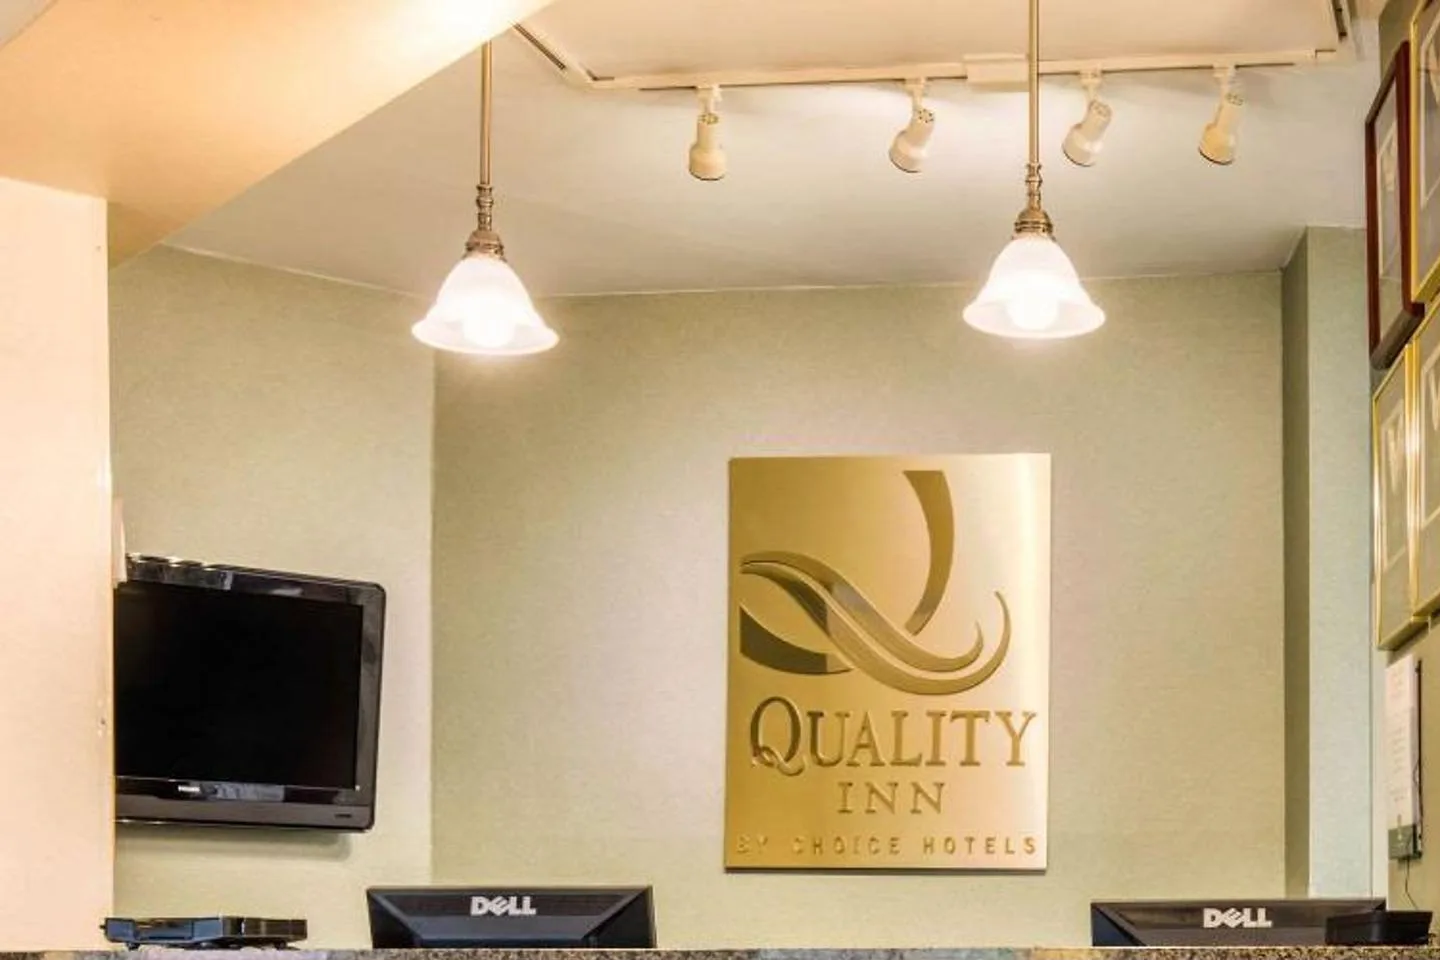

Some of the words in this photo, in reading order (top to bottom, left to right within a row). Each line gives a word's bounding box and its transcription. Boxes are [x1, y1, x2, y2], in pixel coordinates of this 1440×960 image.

[749, 696, 1038, 777] QUALITY
[837, 782, 945, 815] INN
[736, 833, 769, 856] BY
[792, 835, 901, 856] CHOICE
[923, 836, 1037, 856] HOTELS
[470, 895, 537, 917] DELL
[1203, 907, 1273, 929] DELL
